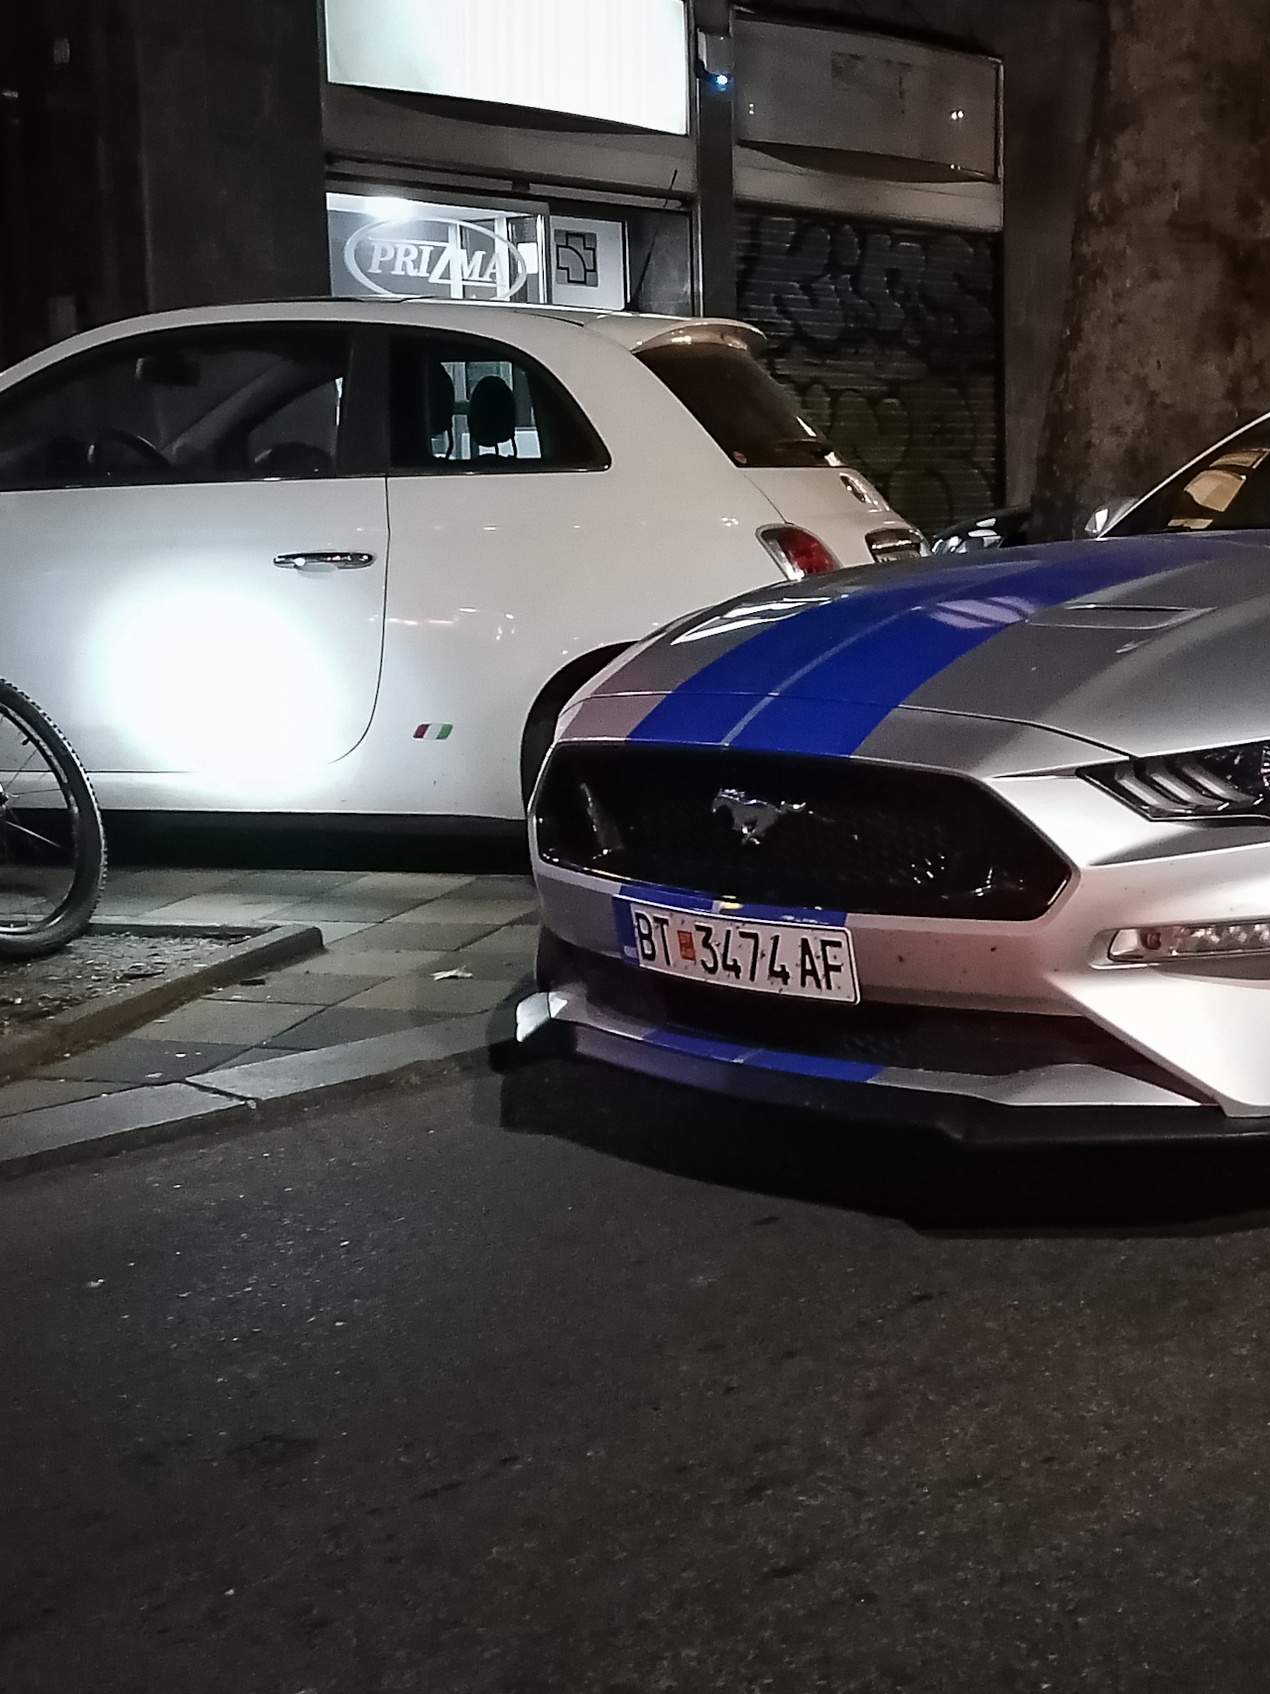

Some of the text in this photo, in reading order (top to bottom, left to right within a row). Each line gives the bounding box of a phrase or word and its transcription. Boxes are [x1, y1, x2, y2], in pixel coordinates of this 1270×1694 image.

[367, 237, 506, 287] PRIZMA
[634, 910, 843, 990] BT 3474 AF
